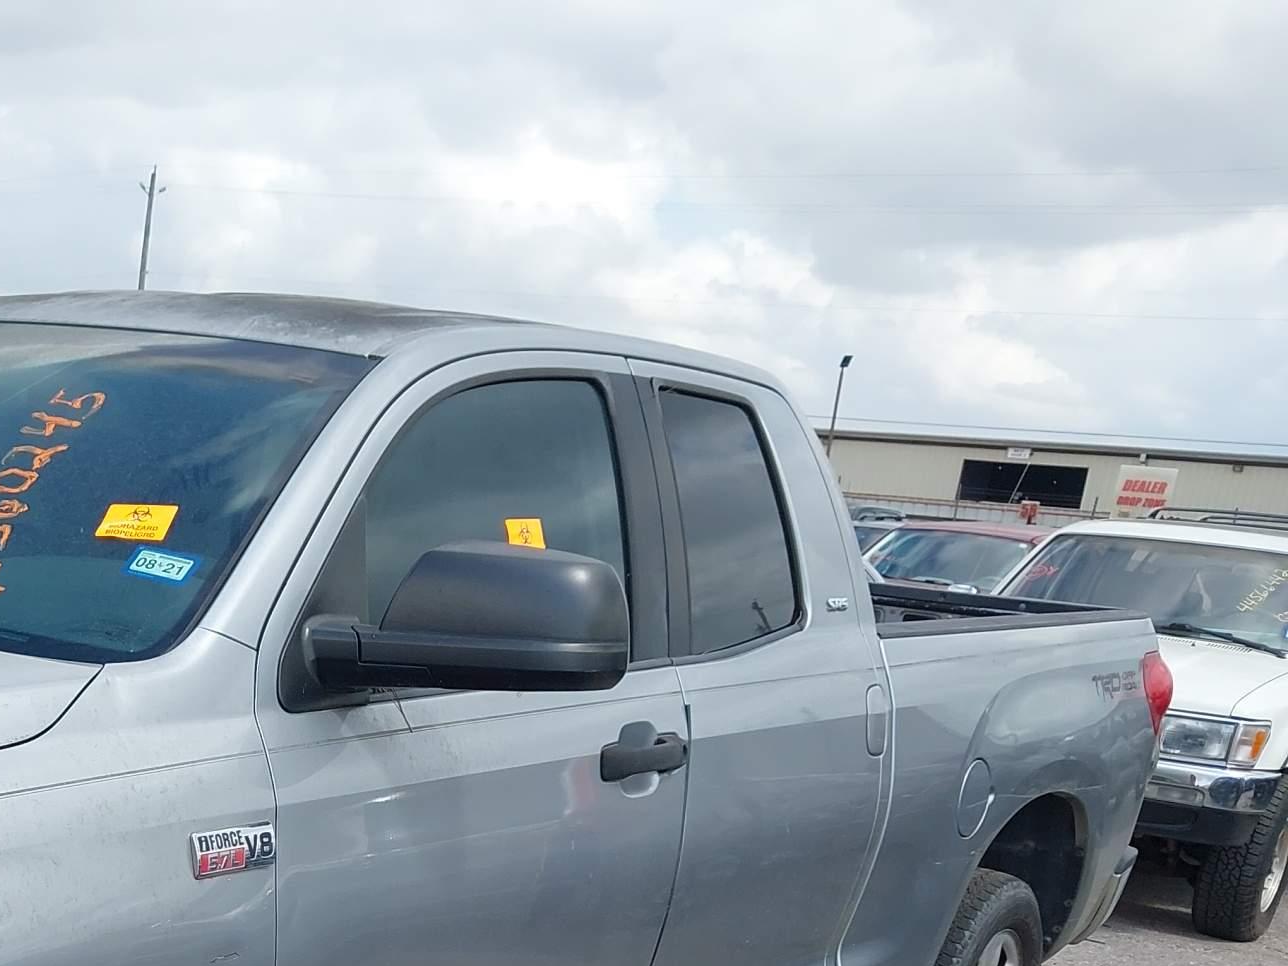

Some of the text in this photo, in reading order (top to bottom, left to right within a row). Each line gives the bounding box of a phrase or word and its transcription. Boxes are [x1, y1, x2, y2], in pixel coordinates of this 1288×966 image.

[1122, 479, 1168, 495] DEALER
[1116, 495, 1142, 506] DROP
[136, 557, 158, 570] 08
[162, 562, 185, 576] 21
[244, 831, 273, 859] V8
